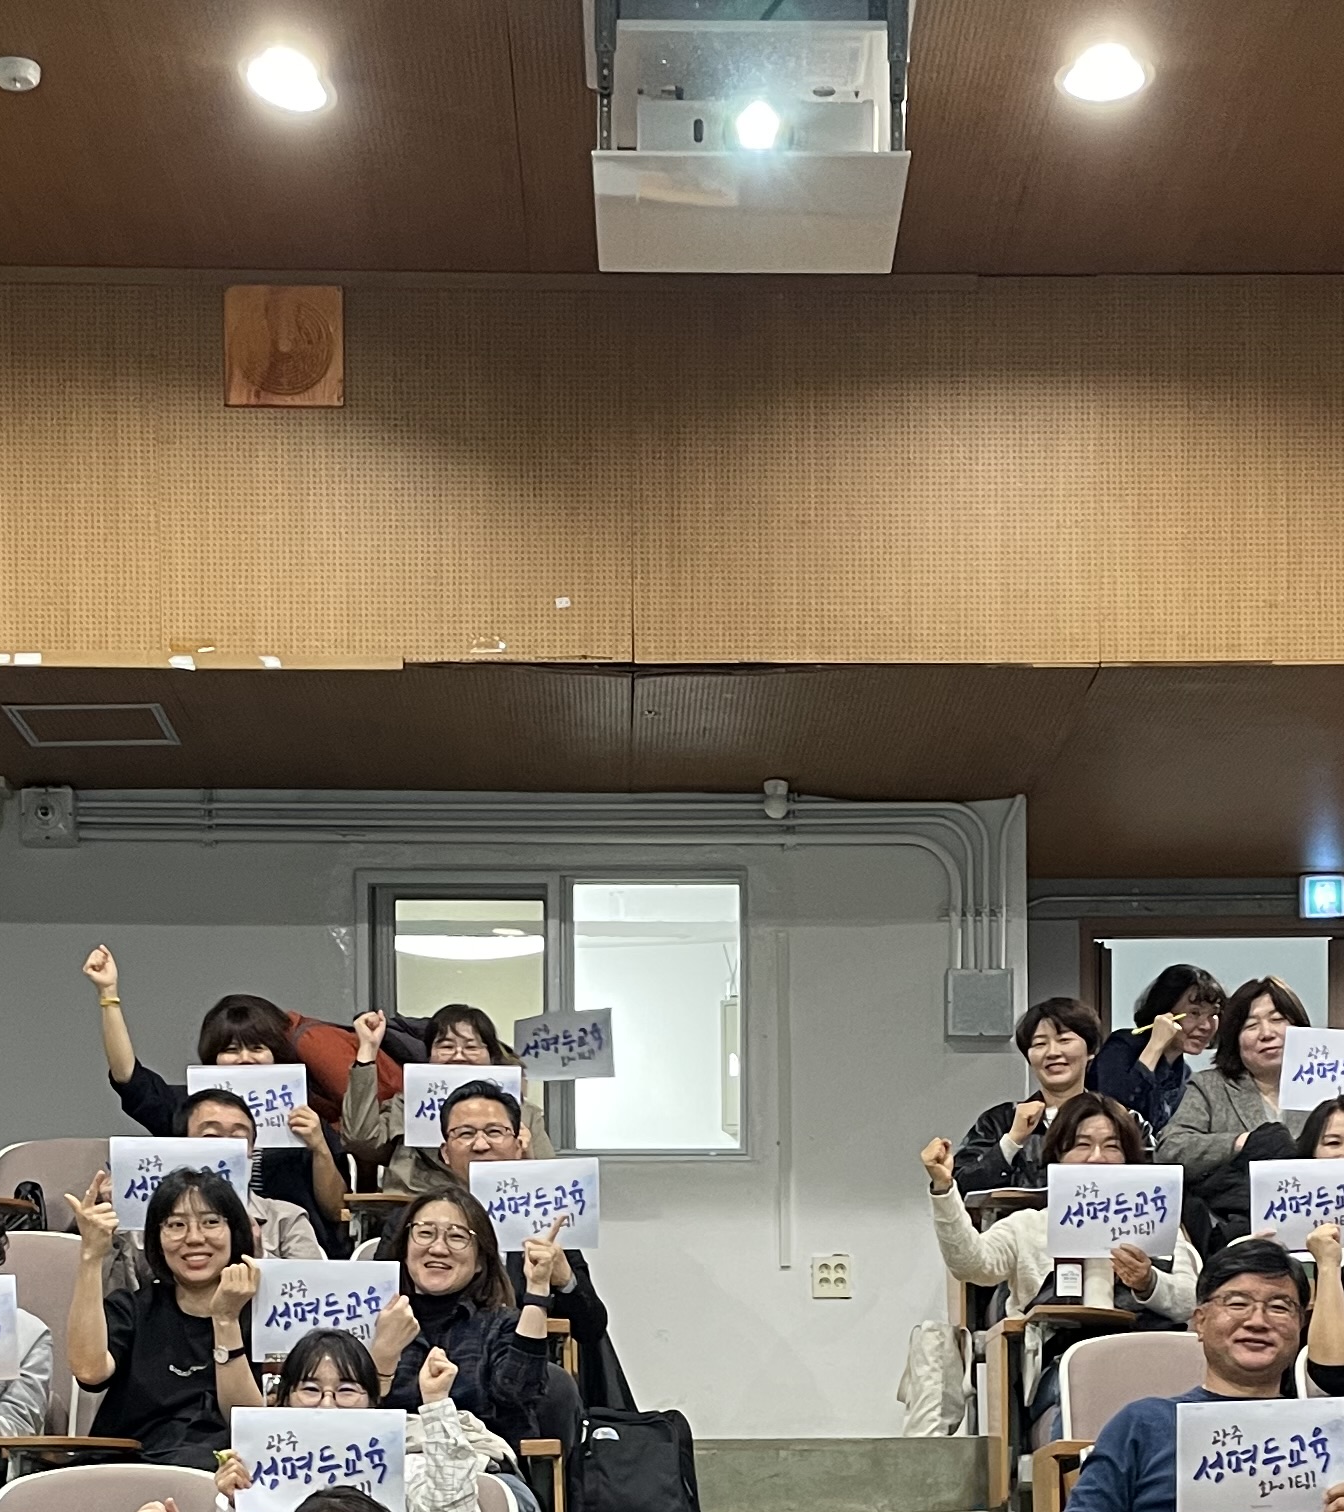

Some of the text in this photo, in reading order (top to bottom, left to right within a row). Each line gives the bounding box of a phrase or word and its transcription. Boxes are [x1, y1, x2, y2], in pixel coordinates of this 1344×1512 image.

[521, 1022, 603, 1057] 성평등교육
[245, 1084, 294, 1117] 등교육
[487, 1180, 585, 1222] 성평등교육
[1060, 1186, 1167, 1228] 성평등교육
[281, 1279, 308, 1298] 광주
[265, 1431, 298, 1452] 광주
[1212, 1425, 1243, 1448] 광주
[252, 1437, 387, 1488] 성평등교육
[1193, 1427, 1331, 1482] 성평등교육
